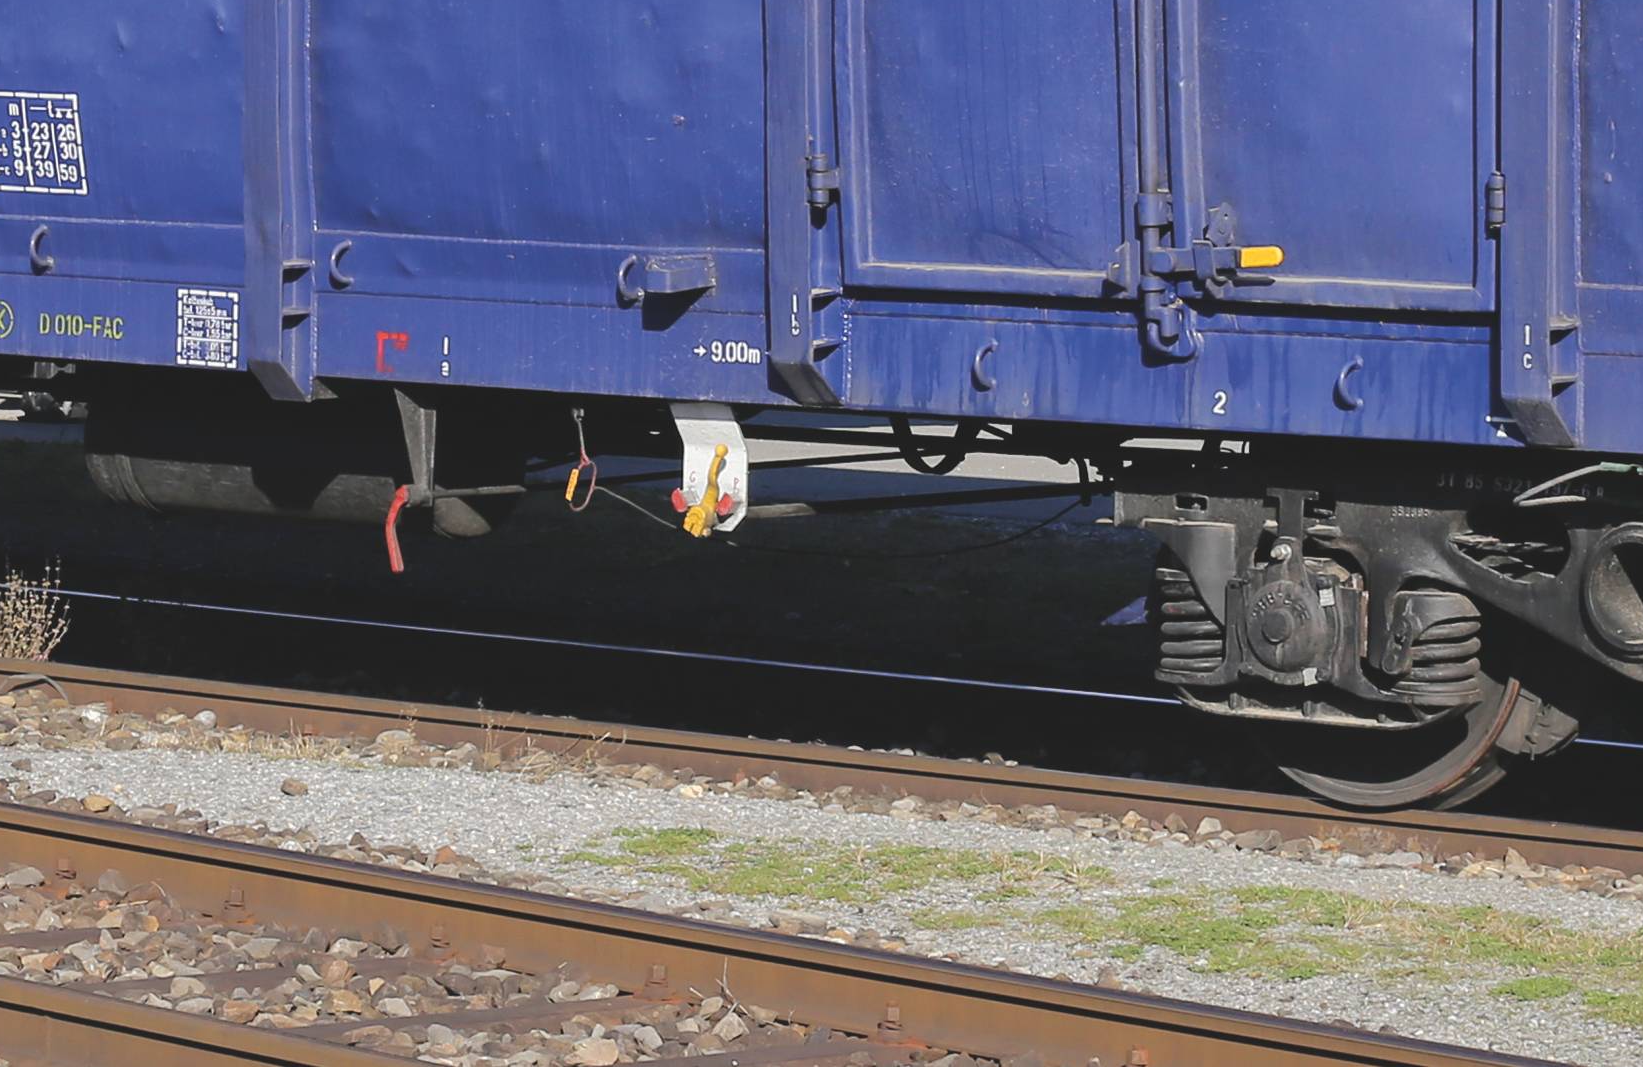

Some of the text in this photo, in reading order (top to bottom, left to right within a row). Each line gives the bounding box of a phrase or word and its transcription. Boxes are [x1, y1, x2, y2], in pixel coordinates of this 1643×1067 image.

[11, 121, 21, 139] 3
[31, 122, 50, 140] 23
[57, 123, 76, 142] 26
[12, 140, 22, 158] 5
[33, 141, 51, 159] 27
[59, 142, 78, 160] 30
[14, 159, 24, 177] 9
[35, 160, 55, 178] 39
[59, 163, 78, 183] 59
[711, 341, 761, 364] 9.00m
[1212, 392, 1227, 414] 2
